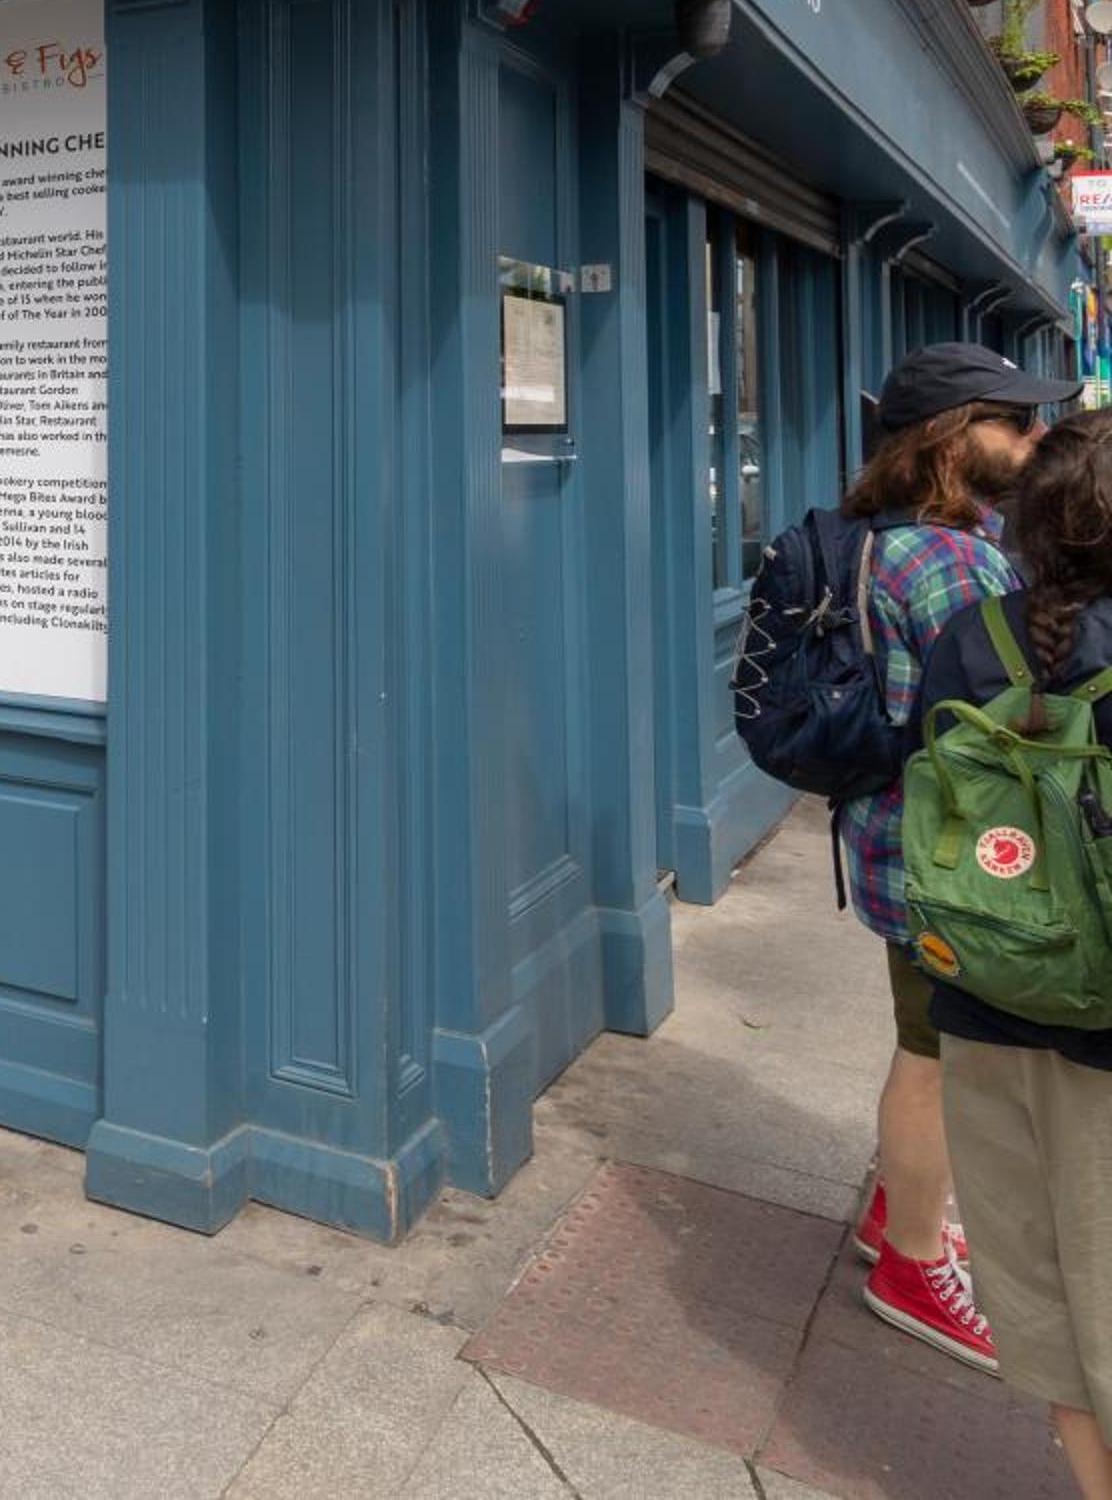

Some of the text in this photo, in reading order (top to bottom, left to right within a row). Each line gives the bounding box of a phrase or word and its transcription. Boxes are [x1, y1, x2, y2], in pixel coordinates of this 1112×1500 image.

[35, 42, 103, 88] Figs
[64, 131, 105, 152] CHE
[1080, 193, 1112, 205] RE/
